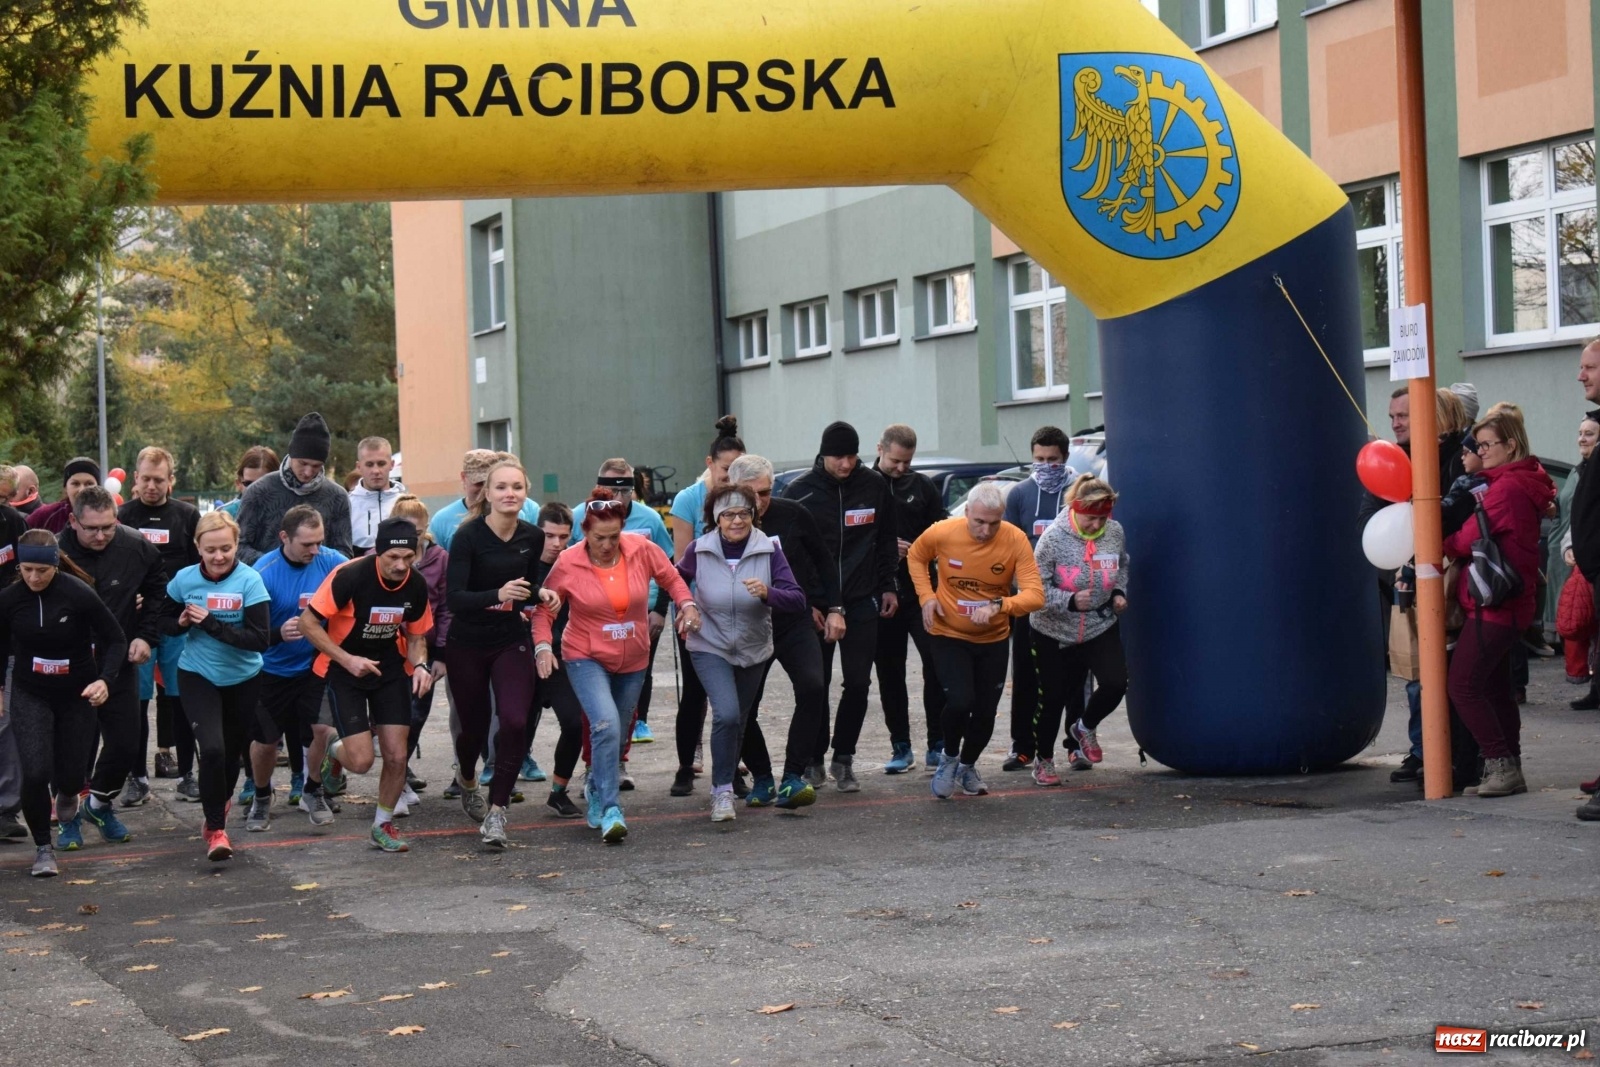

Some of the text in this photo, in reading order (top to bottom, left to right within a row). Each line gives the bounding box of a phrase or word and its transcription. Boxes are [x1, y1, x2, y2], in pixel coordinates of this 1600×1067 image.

[398, 0, 637, 29] GMINA
[123, 50, 896, 119] KUŹNIA RACIBORSKA
[1400, 323, 1418, 337] BIURO
[1393, 345, 1426, 363] ZAWODÓW
[854, 515, 867, 523] 077
[216, 599, 233, 609] 110
[379, 613, 394, 623] 091
[611, 631, 628, 640] 038
[42, 665, 59, 674] 081
